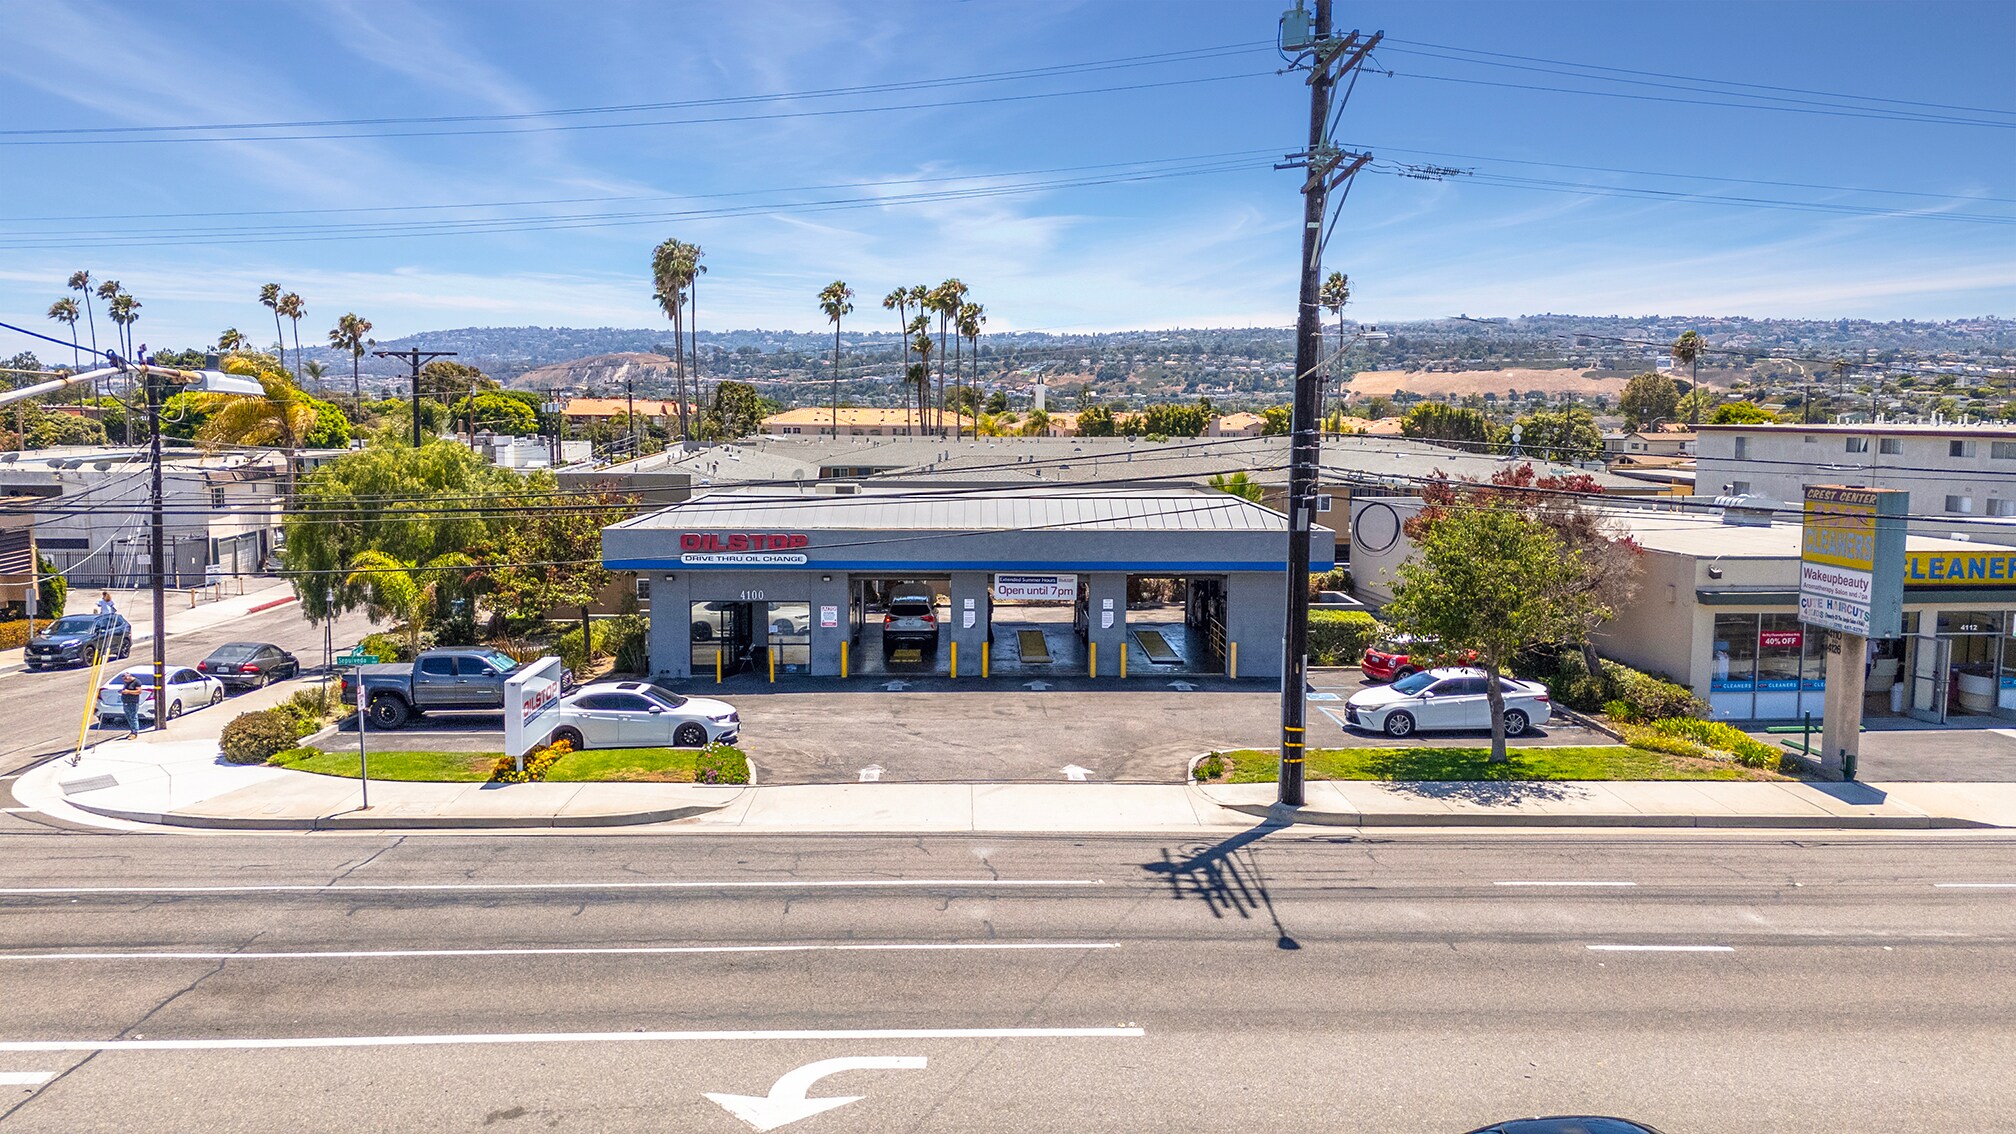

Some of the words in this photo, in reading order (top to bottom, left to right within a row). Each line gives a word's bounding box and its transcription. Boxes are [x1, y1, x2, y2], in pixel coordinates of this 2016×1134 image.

[1807, 489, 1837, 500] CREST
[1840, 492, 1877, 504] CENTER
[680, 533, 808, 551] OILSTOP
[1806, 528, 1872, 561] CLEANERS
[1904, 557, 2016, 579] LEANE
[1803, 567, 1869, 592] Wakeupbeauty
[740, 590, 764, 600] 4100
[998, 585, 1025, 597] Open
[1027, 585, 1048, 595] until
[1051, 586, 1073, 598] 7pm
[1803, 582, 1834, 594] Aromatherapy
[1835, 587, 1848, 596] Salon
[1801, 598, 1823, 608] CUTE
[1827, 599, 1870, 622] HAIRCUTS
[1765, 637, 1781, 645] 40%
[1781, 637, 1797, 645] OFF
[1828, 629, 1842, 640] 4110
[1827, 643, 1841, 655] 4126
[523, 681, 557, 717] OILSTOP
